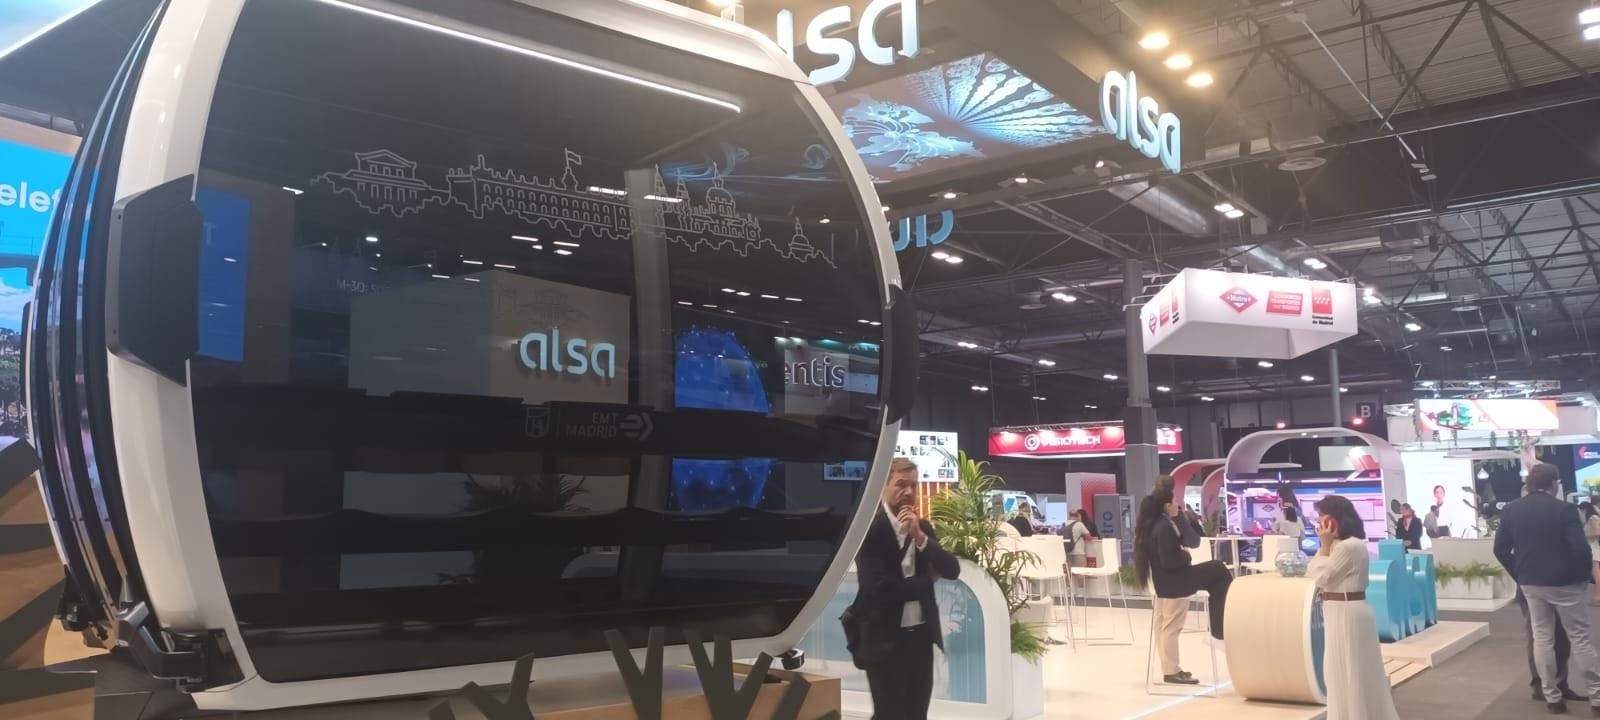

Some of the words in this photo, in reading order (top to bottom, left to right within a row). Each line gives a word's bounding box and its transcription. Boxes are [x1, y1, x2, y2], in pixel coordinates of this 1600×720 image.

[777, 0, 920, 87] lsa
[1100, 70, 1181, 174] alsa
[520, 326, 616, 379] alsa
[592, 411, 617, 425] EMT
[1360, 404, 1371, 418] B
[566, 423, 618, 439] MADRID
